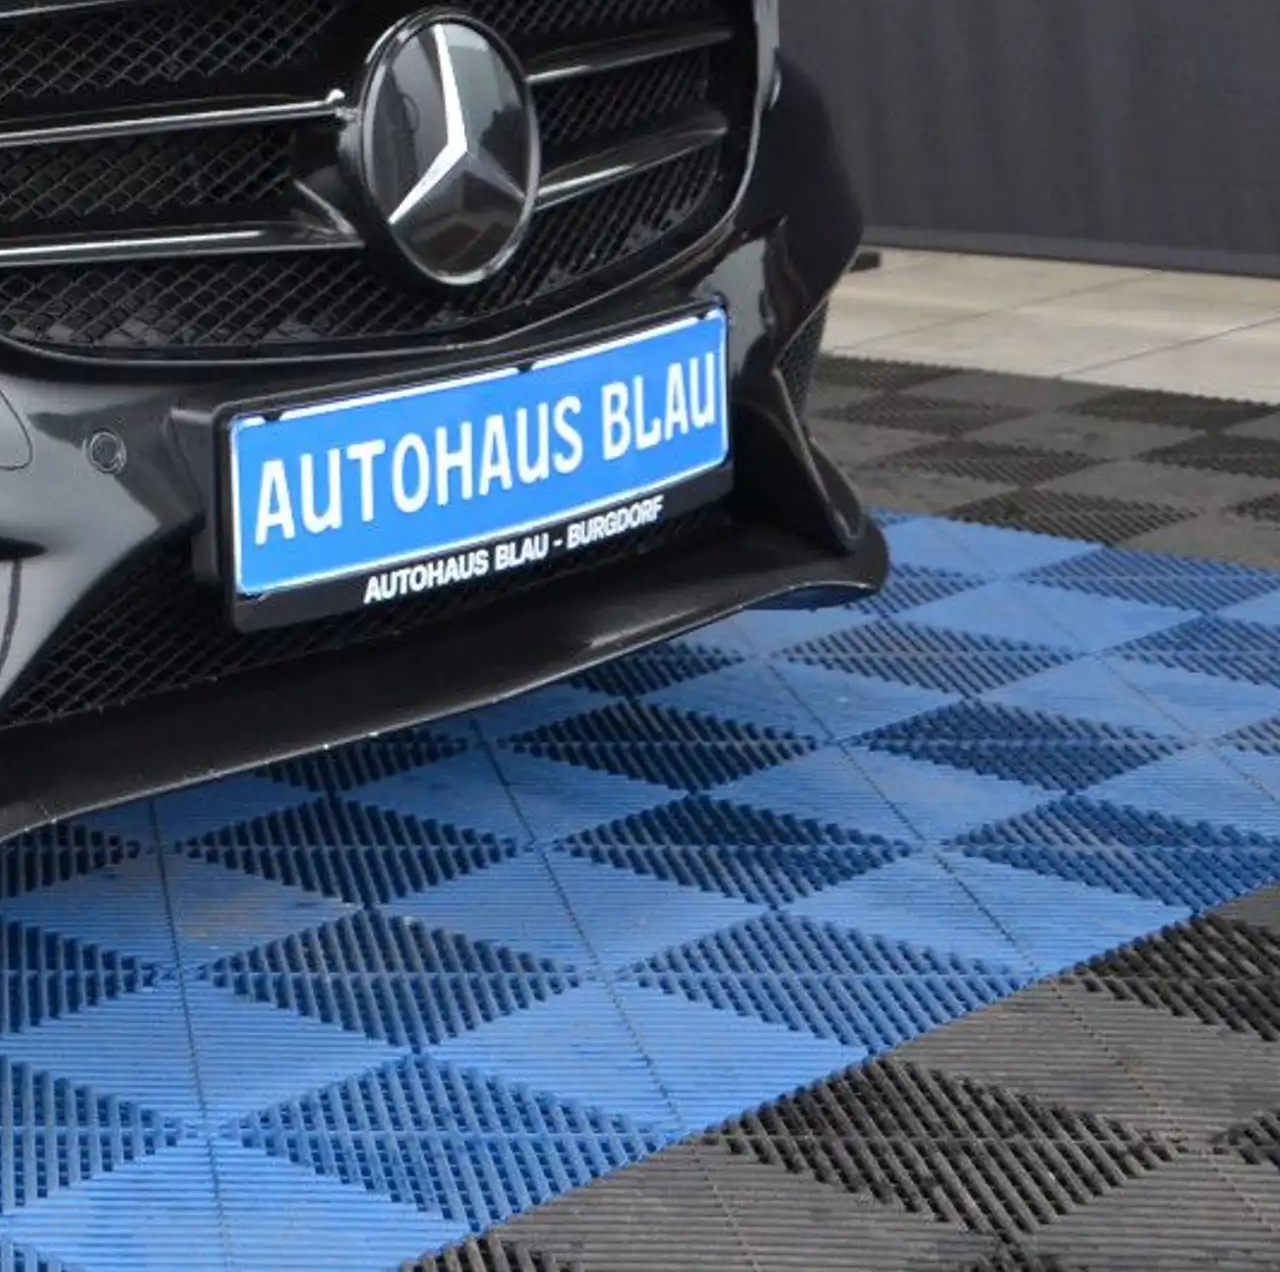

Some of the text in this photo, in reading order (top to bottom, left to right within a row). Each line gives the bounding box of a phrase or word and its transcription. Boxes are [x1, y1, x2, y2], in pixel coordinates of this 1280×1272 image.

[255, 352, 715, 545] AUTOHAUS BLAU
[363, 550, 490, 604] AUTOHAUS
[495, 533, 549, 571] BLAU
[567, 495, 665, 550] BURGDORF
